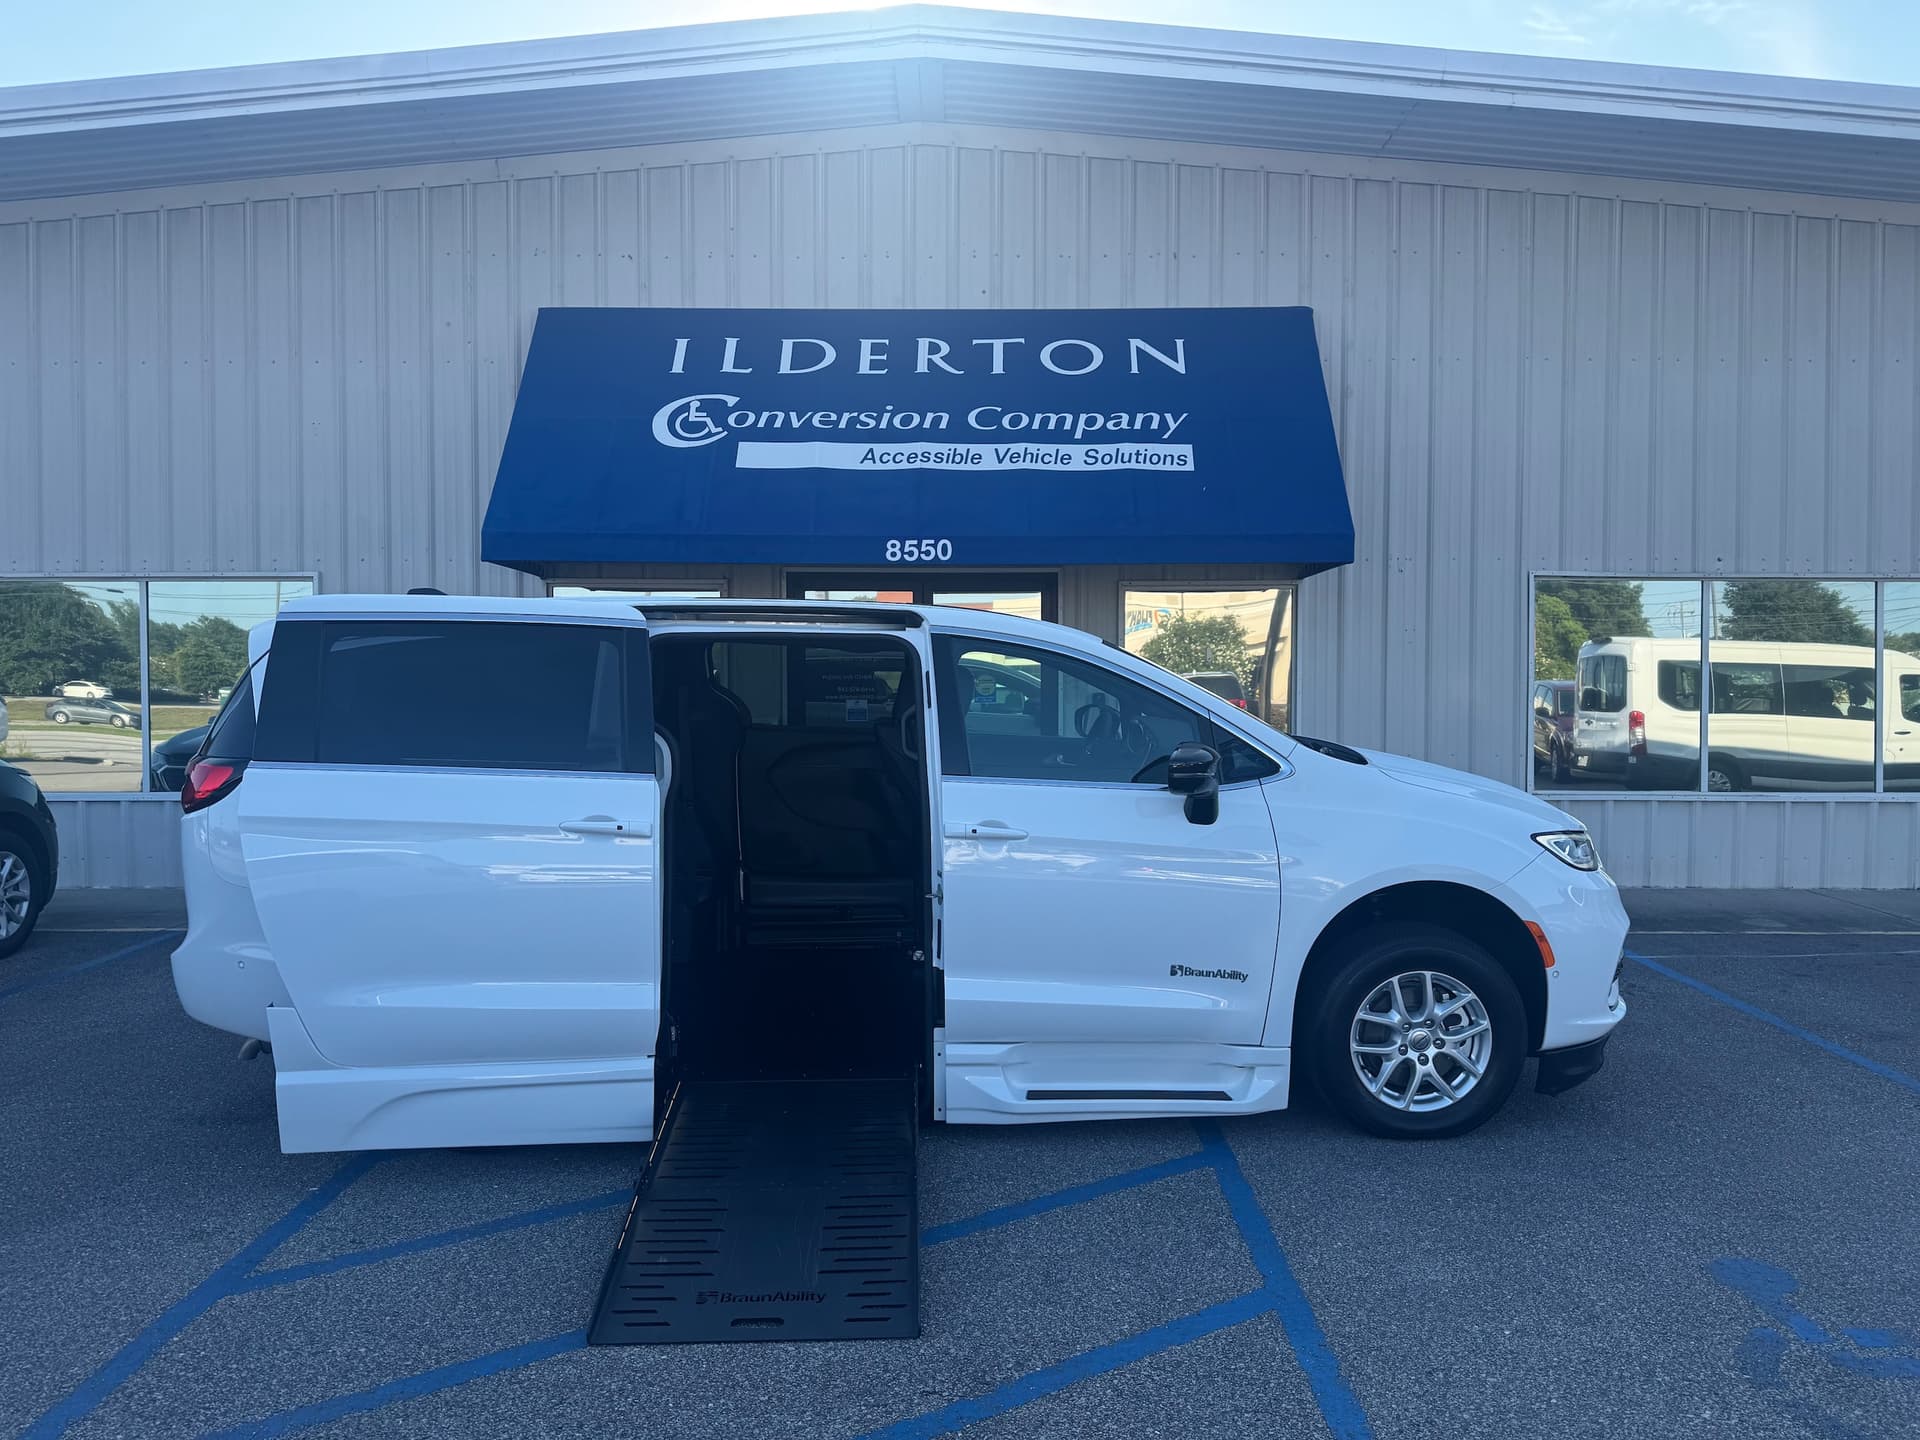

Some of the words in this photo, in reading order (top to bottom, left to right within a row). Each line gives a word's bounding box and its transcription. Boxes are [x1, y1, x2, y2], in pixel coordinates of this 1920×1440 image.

[669, 337, 1188, 375] ILDERTON
[652, 394, 949, 448] Conversion
[967, 405, 1189, 439] Company
[860, 446, 983, 466] Accessible
[994, 447, 1073, 467] Vehicle
[1083, 447, 1189, 468] Solutions
[884, 538, 953, 562] 8550
[1184, 966, 1249, 983] BraunAbility
[720, 1291, 827, 1304] BraunAbility
